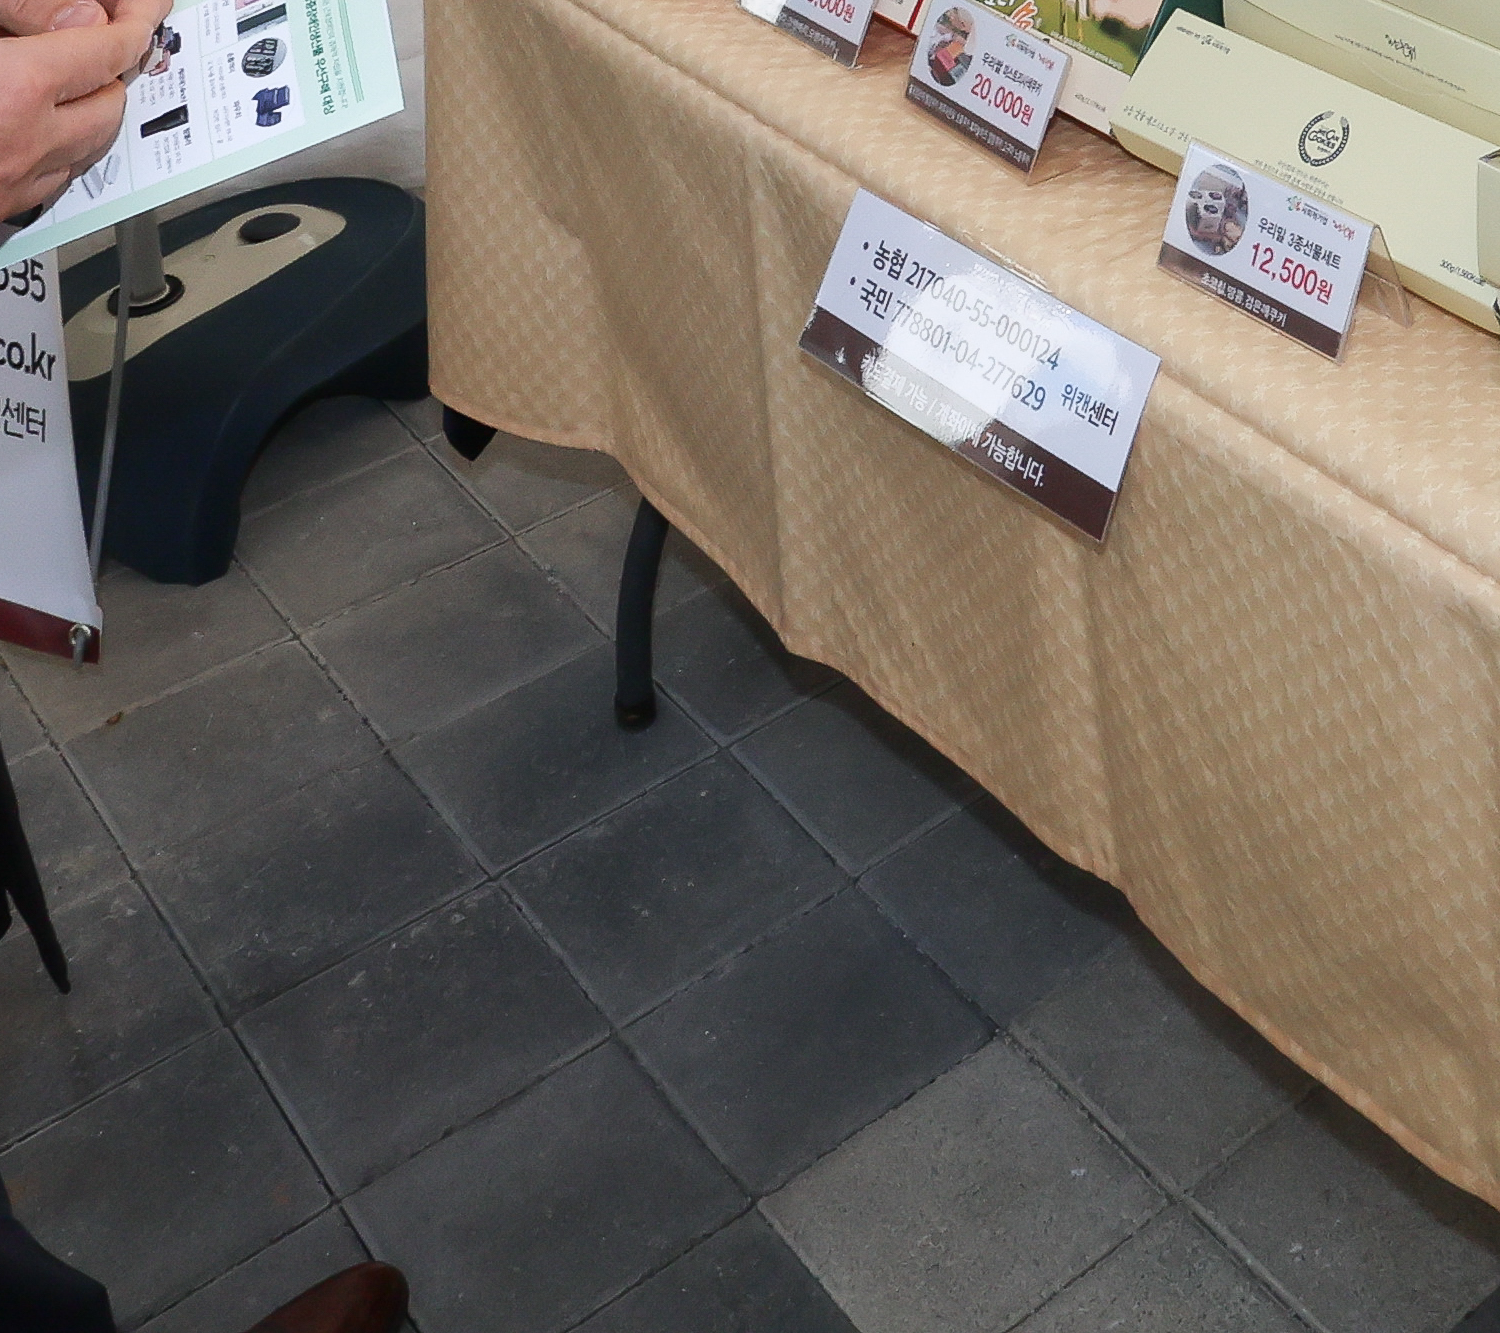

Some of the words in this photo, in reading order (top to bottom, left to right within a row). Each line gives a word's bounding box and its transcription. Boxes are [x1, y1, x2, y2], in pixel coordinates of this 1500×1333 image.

[970, 72, 1035, 127] 20,000원
[873, 238, 909, 281] 농협
[1249, 241, 1333, 306] 12,500원
[1257, 217, 1287, 244] 우리밀
[1287, 232, 1343, 270] 3종선물세트
[859, 277, 894, 320] 국민
[1060, 383, 1121, 436] 위캔센터
[905, 380, 930, 409] 가능
[983, 431, 1045, 488] 가능합니다.
